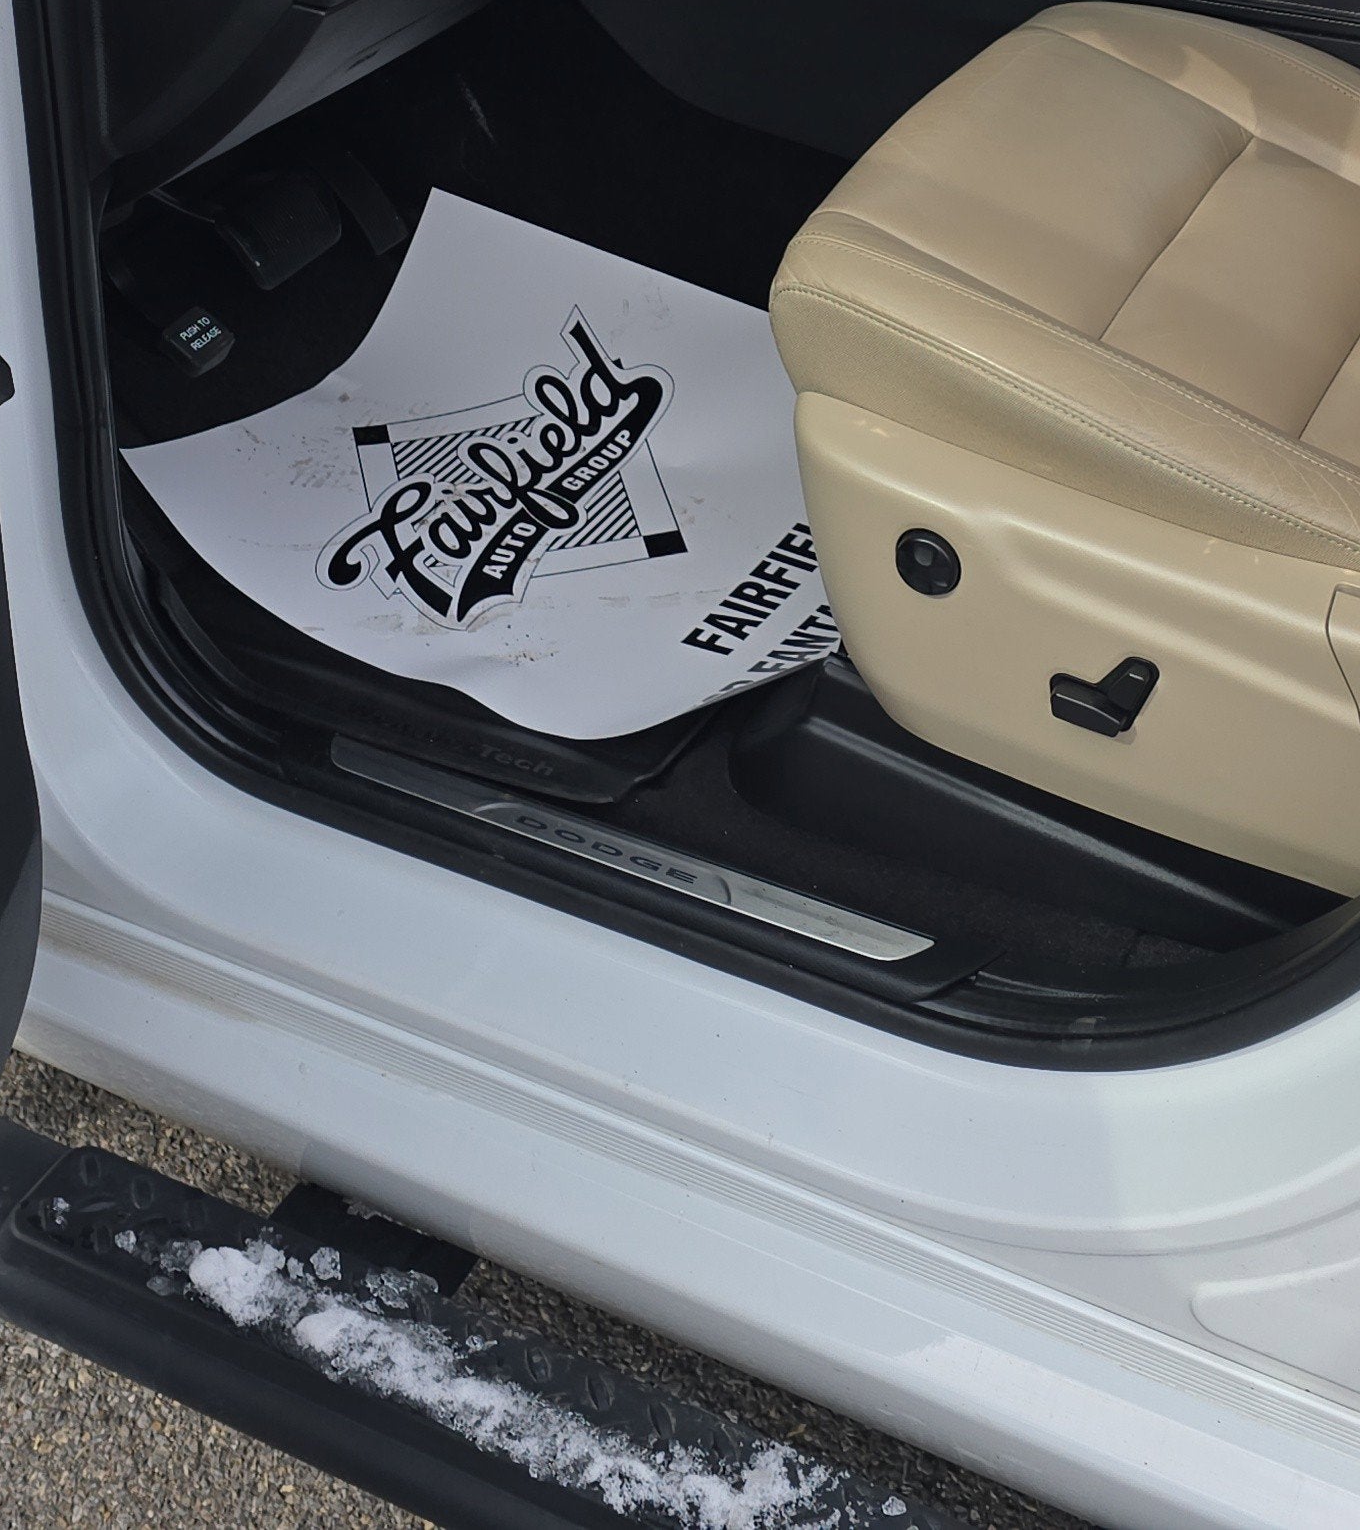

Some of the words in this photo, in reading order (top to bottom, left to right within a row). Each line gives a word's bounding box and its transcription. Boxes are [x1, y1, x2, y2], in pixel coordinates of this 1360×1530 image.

[180, 323, 201, 341] PUSH
[197, 316, 211, 327] TO
[190, 326, 222, 351] RELEASE
[327, 320, 664, 618] Fairfield
[482, 522, 538, 580] AUTO
[561, 429, 632, 492] GROUP
[680, 522, 819, 656] FAIRFIE
[514, 815, 698, 885] DODGE
